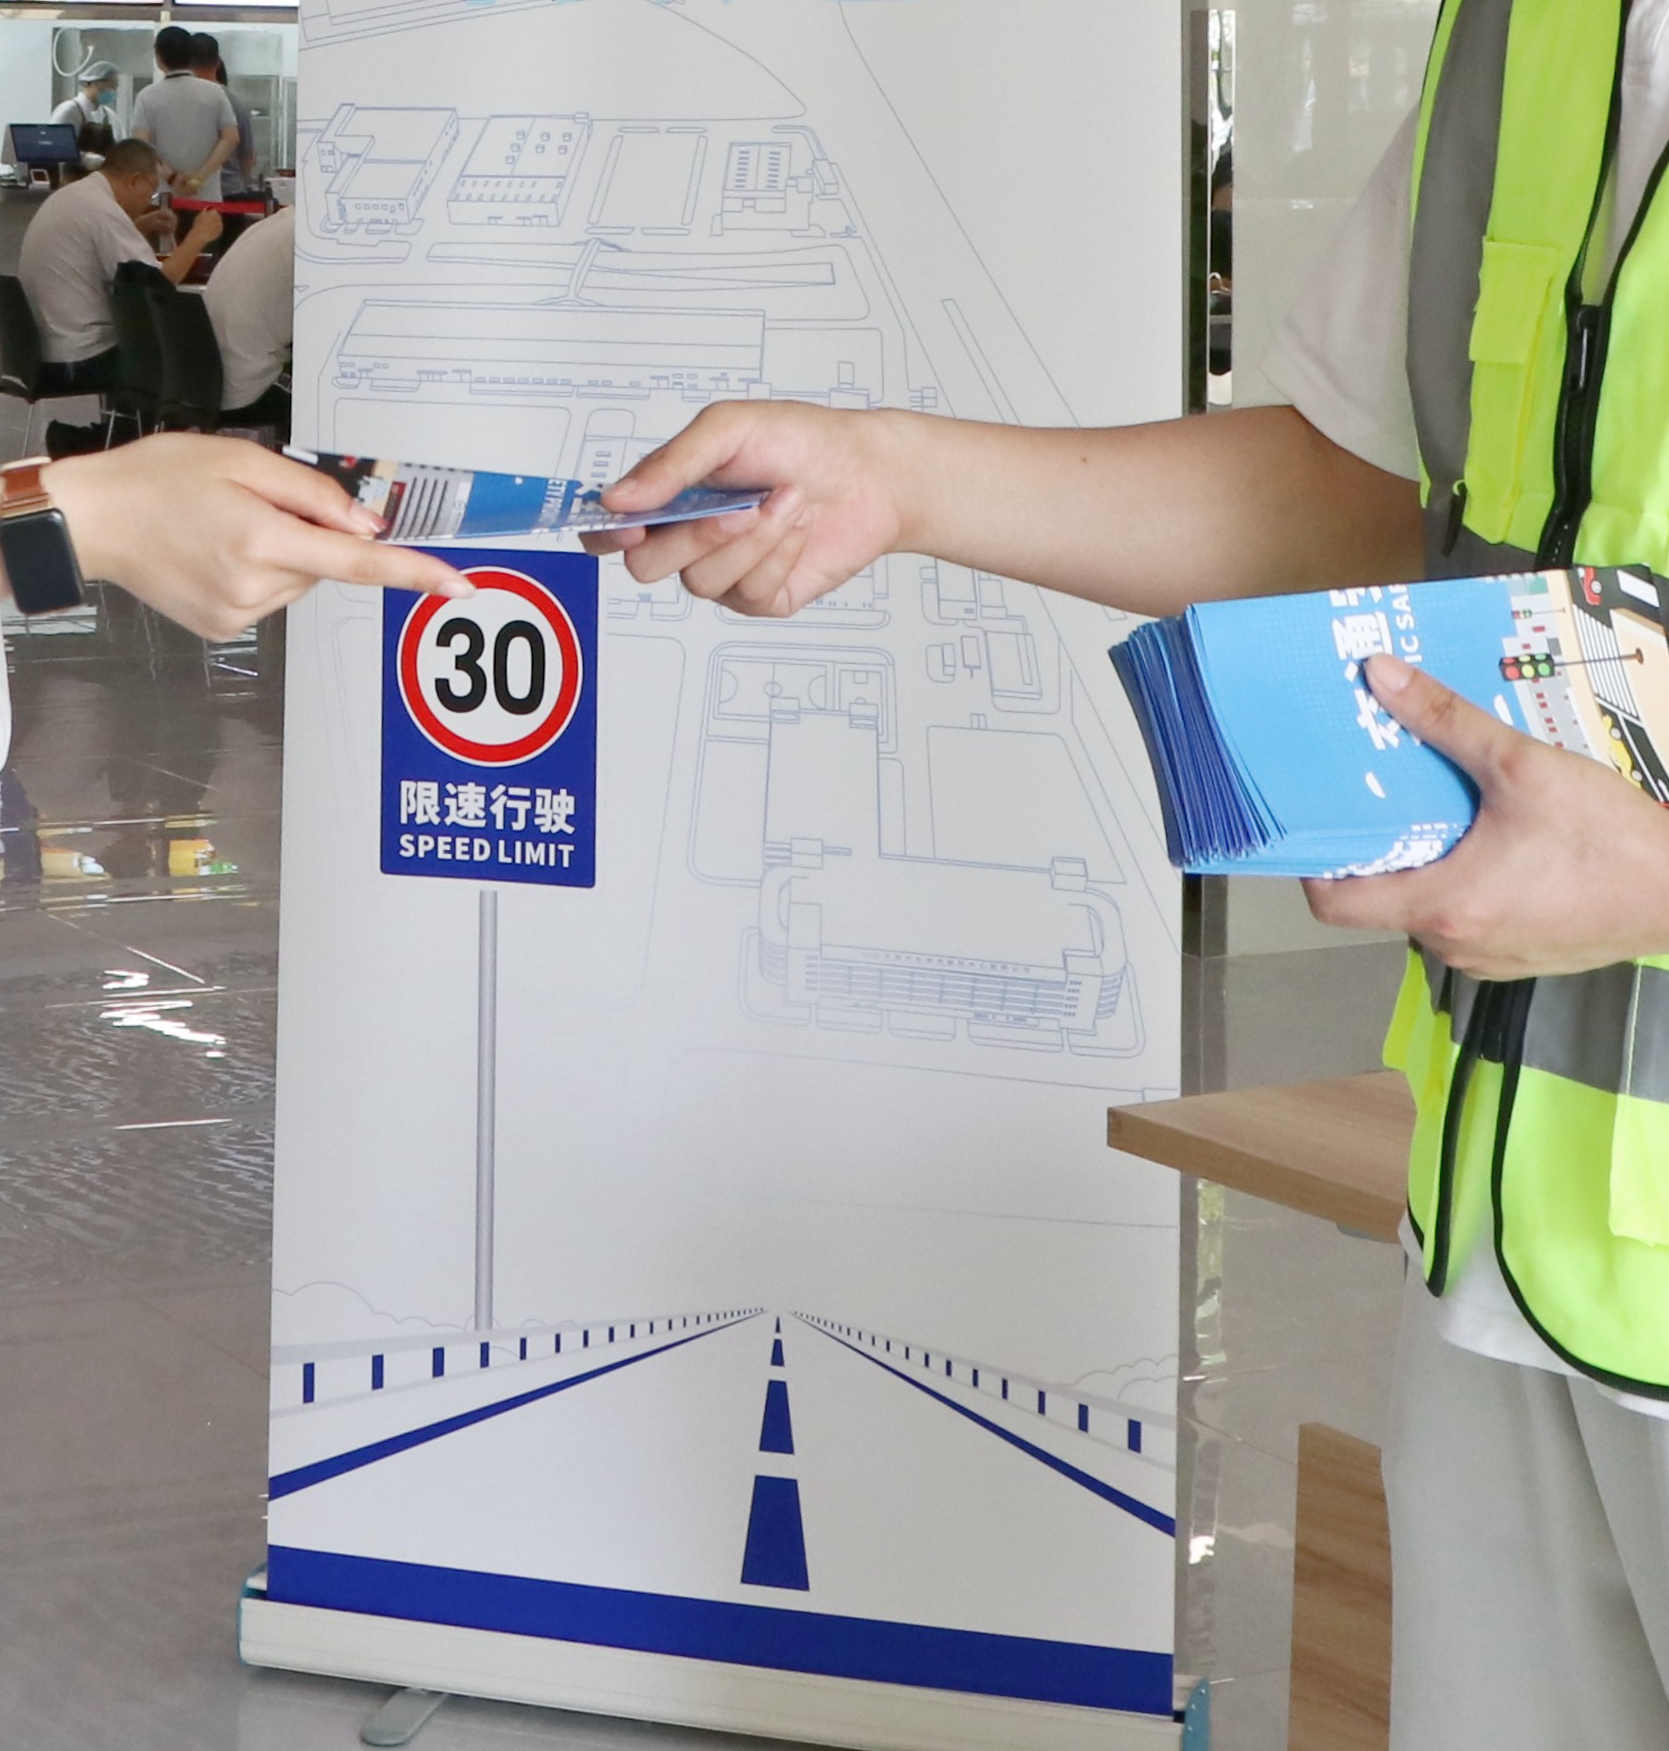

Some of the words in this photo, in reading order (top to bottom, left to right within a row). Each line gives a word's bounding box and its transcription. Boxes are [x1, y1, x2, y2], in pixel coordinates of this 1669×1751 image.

[435, 617, 546, 715] 30
[400, 780, 575, 834] 限速行驶
[399, 834, 491, 862] SPEED
[498, 839, 575, 868] LIMIT
